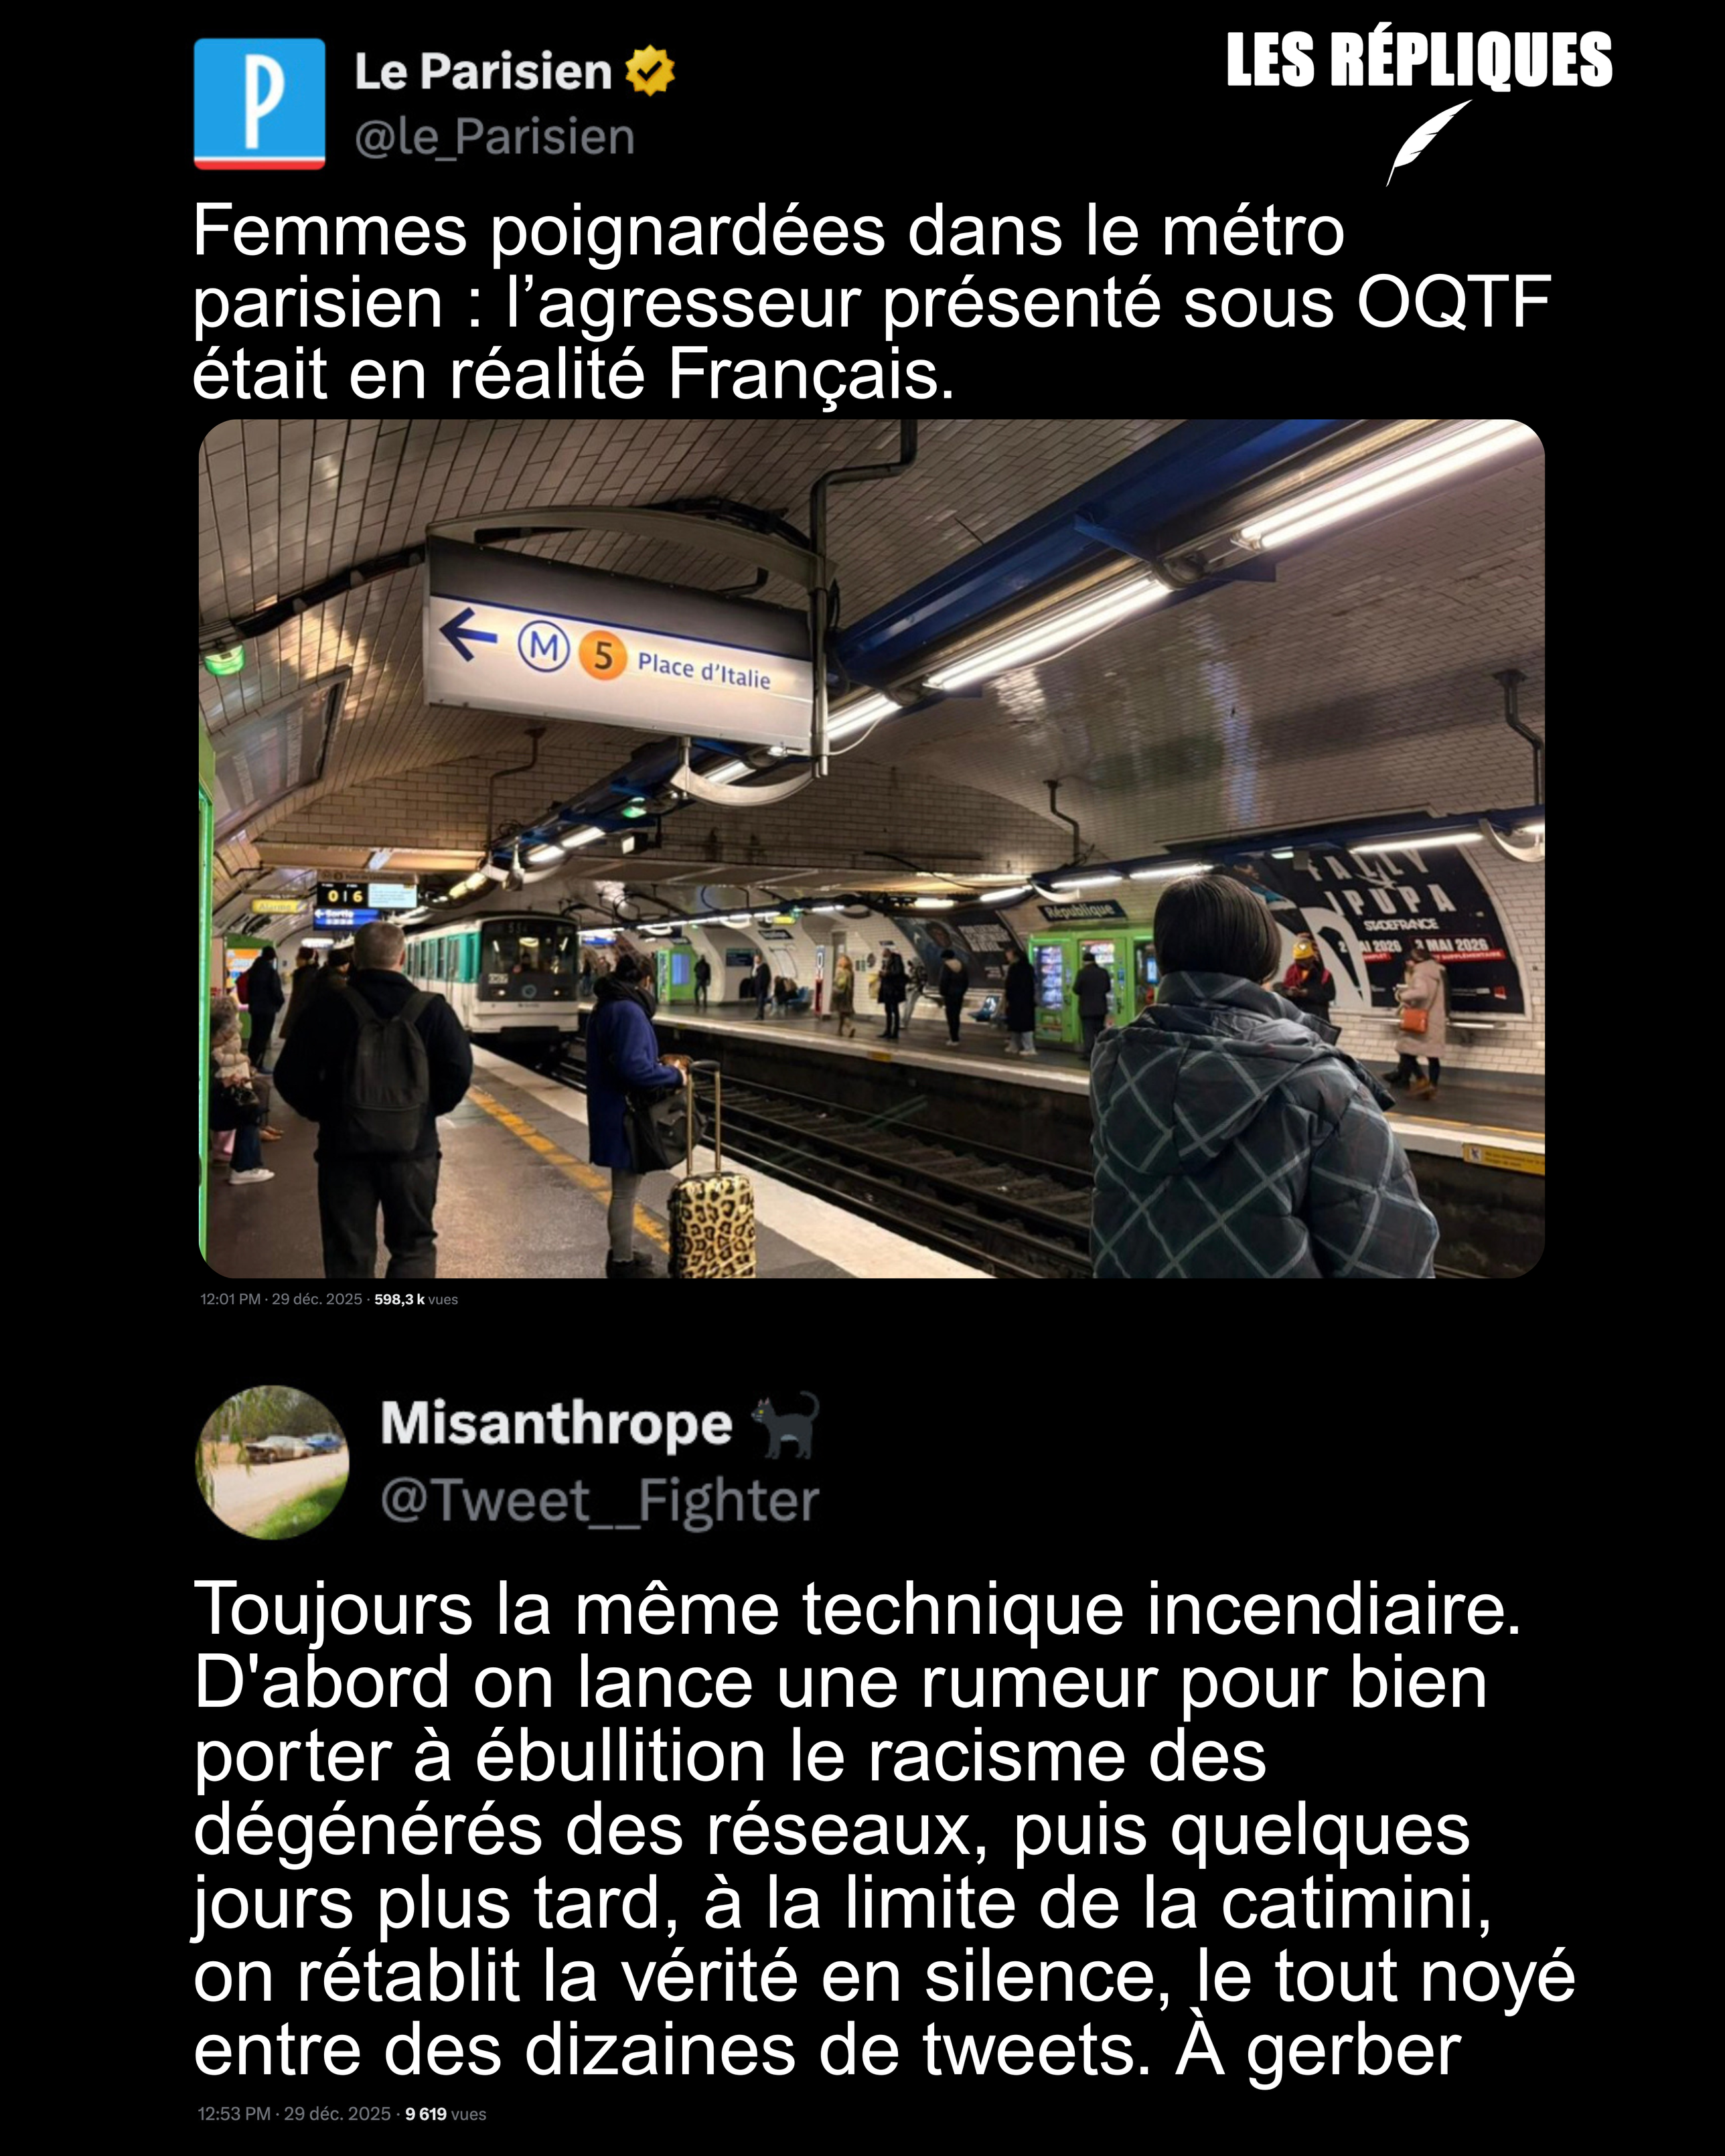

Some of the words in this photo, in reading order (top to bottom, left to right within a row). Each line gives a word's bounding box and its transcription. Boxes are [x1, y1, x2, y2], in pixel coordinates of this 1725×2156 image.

[530, 631, 558, 662] M
[595, 641, 613, 670] 5
[639, 652, 694, 678] Place
[701, 664, 771, 690] d’Italie
[327, 890, 339, 903] 0
[353, 891, 364, 903] 6
[1324, 884, 1456, 915] IPUPA
[1045, 903, 1115, 920] République
[1373, 939, 1403, 953] 2026
[1426, 939, 1454, 952] MAI
[1454, 937, 1489, 952] 2026
